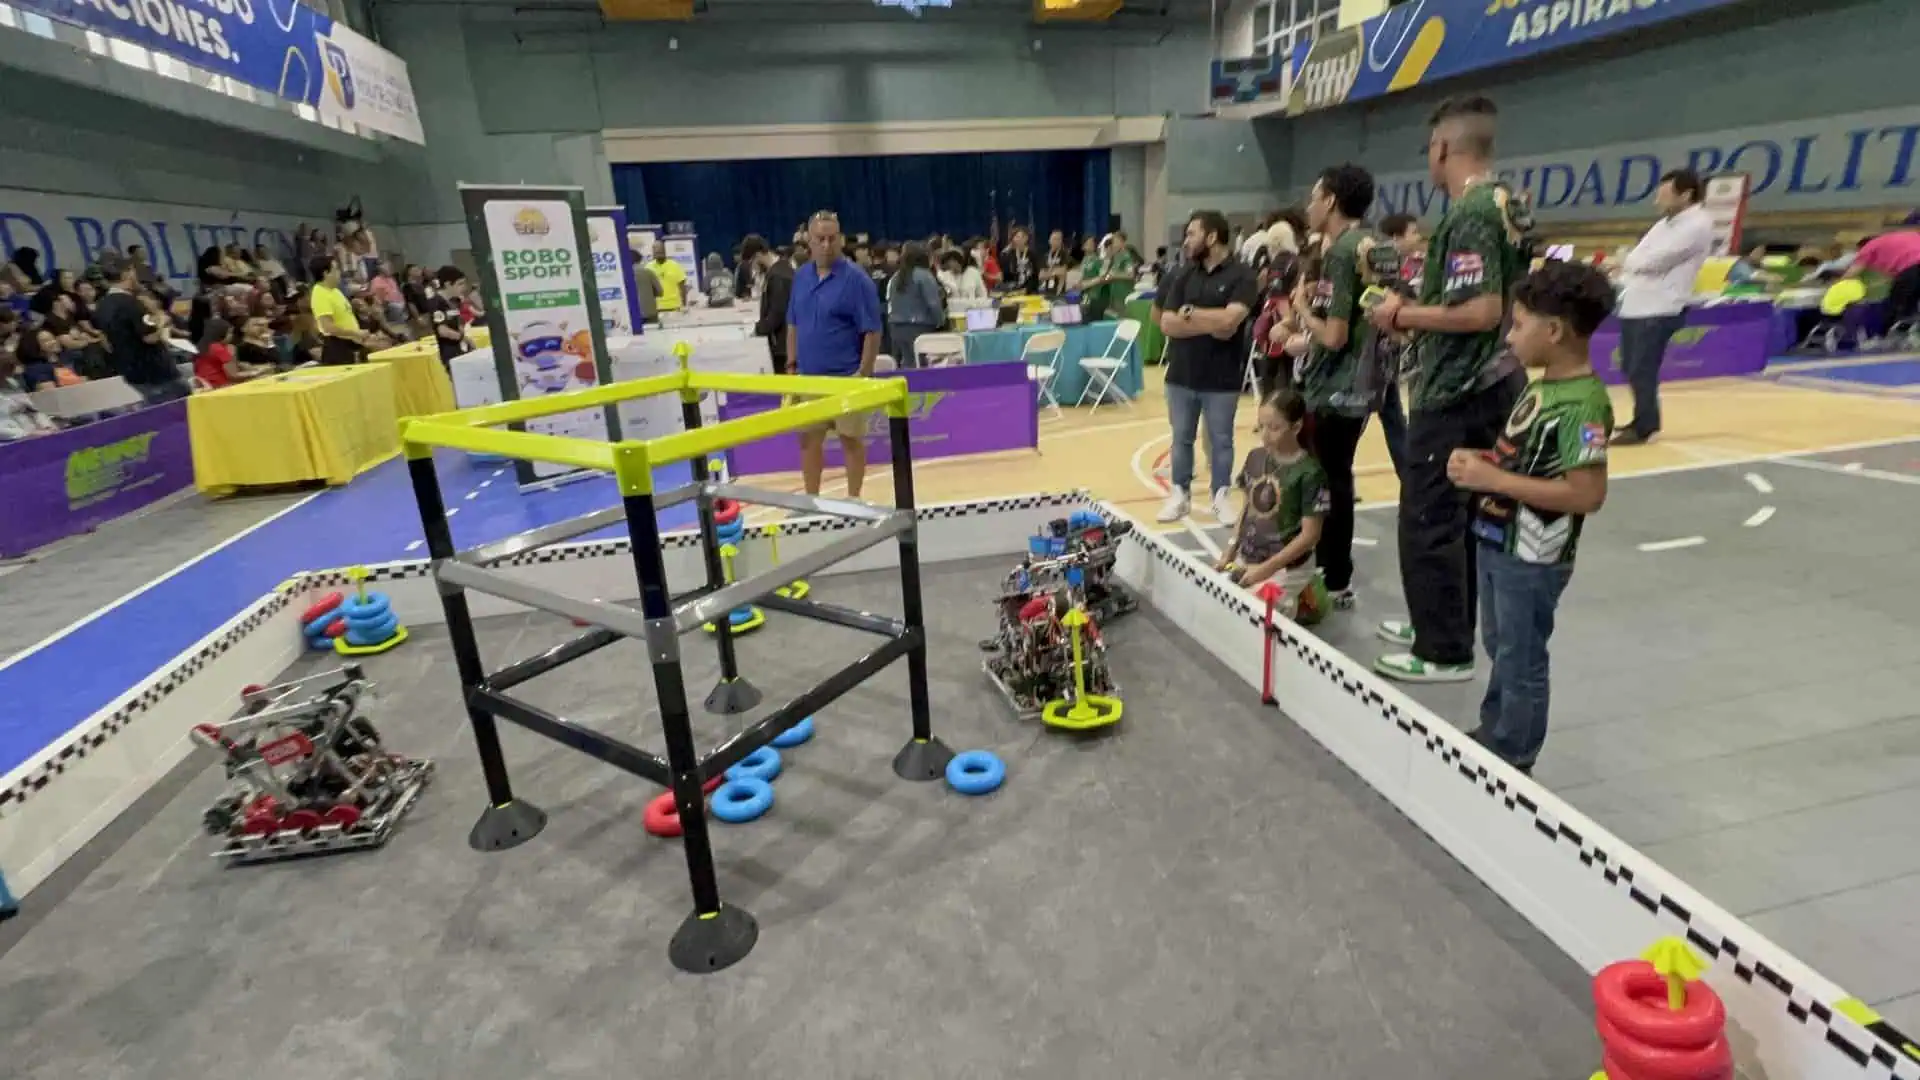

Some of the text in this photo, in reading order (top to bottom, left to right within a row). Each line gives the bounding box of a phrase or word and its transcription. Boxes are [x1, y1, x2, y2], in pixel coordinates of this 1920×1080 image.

[1505, 0, 1662, 47] ASPIRA
[502, 247, 571, 265] ROBO
[503, 263, 573, 281] SPORT
